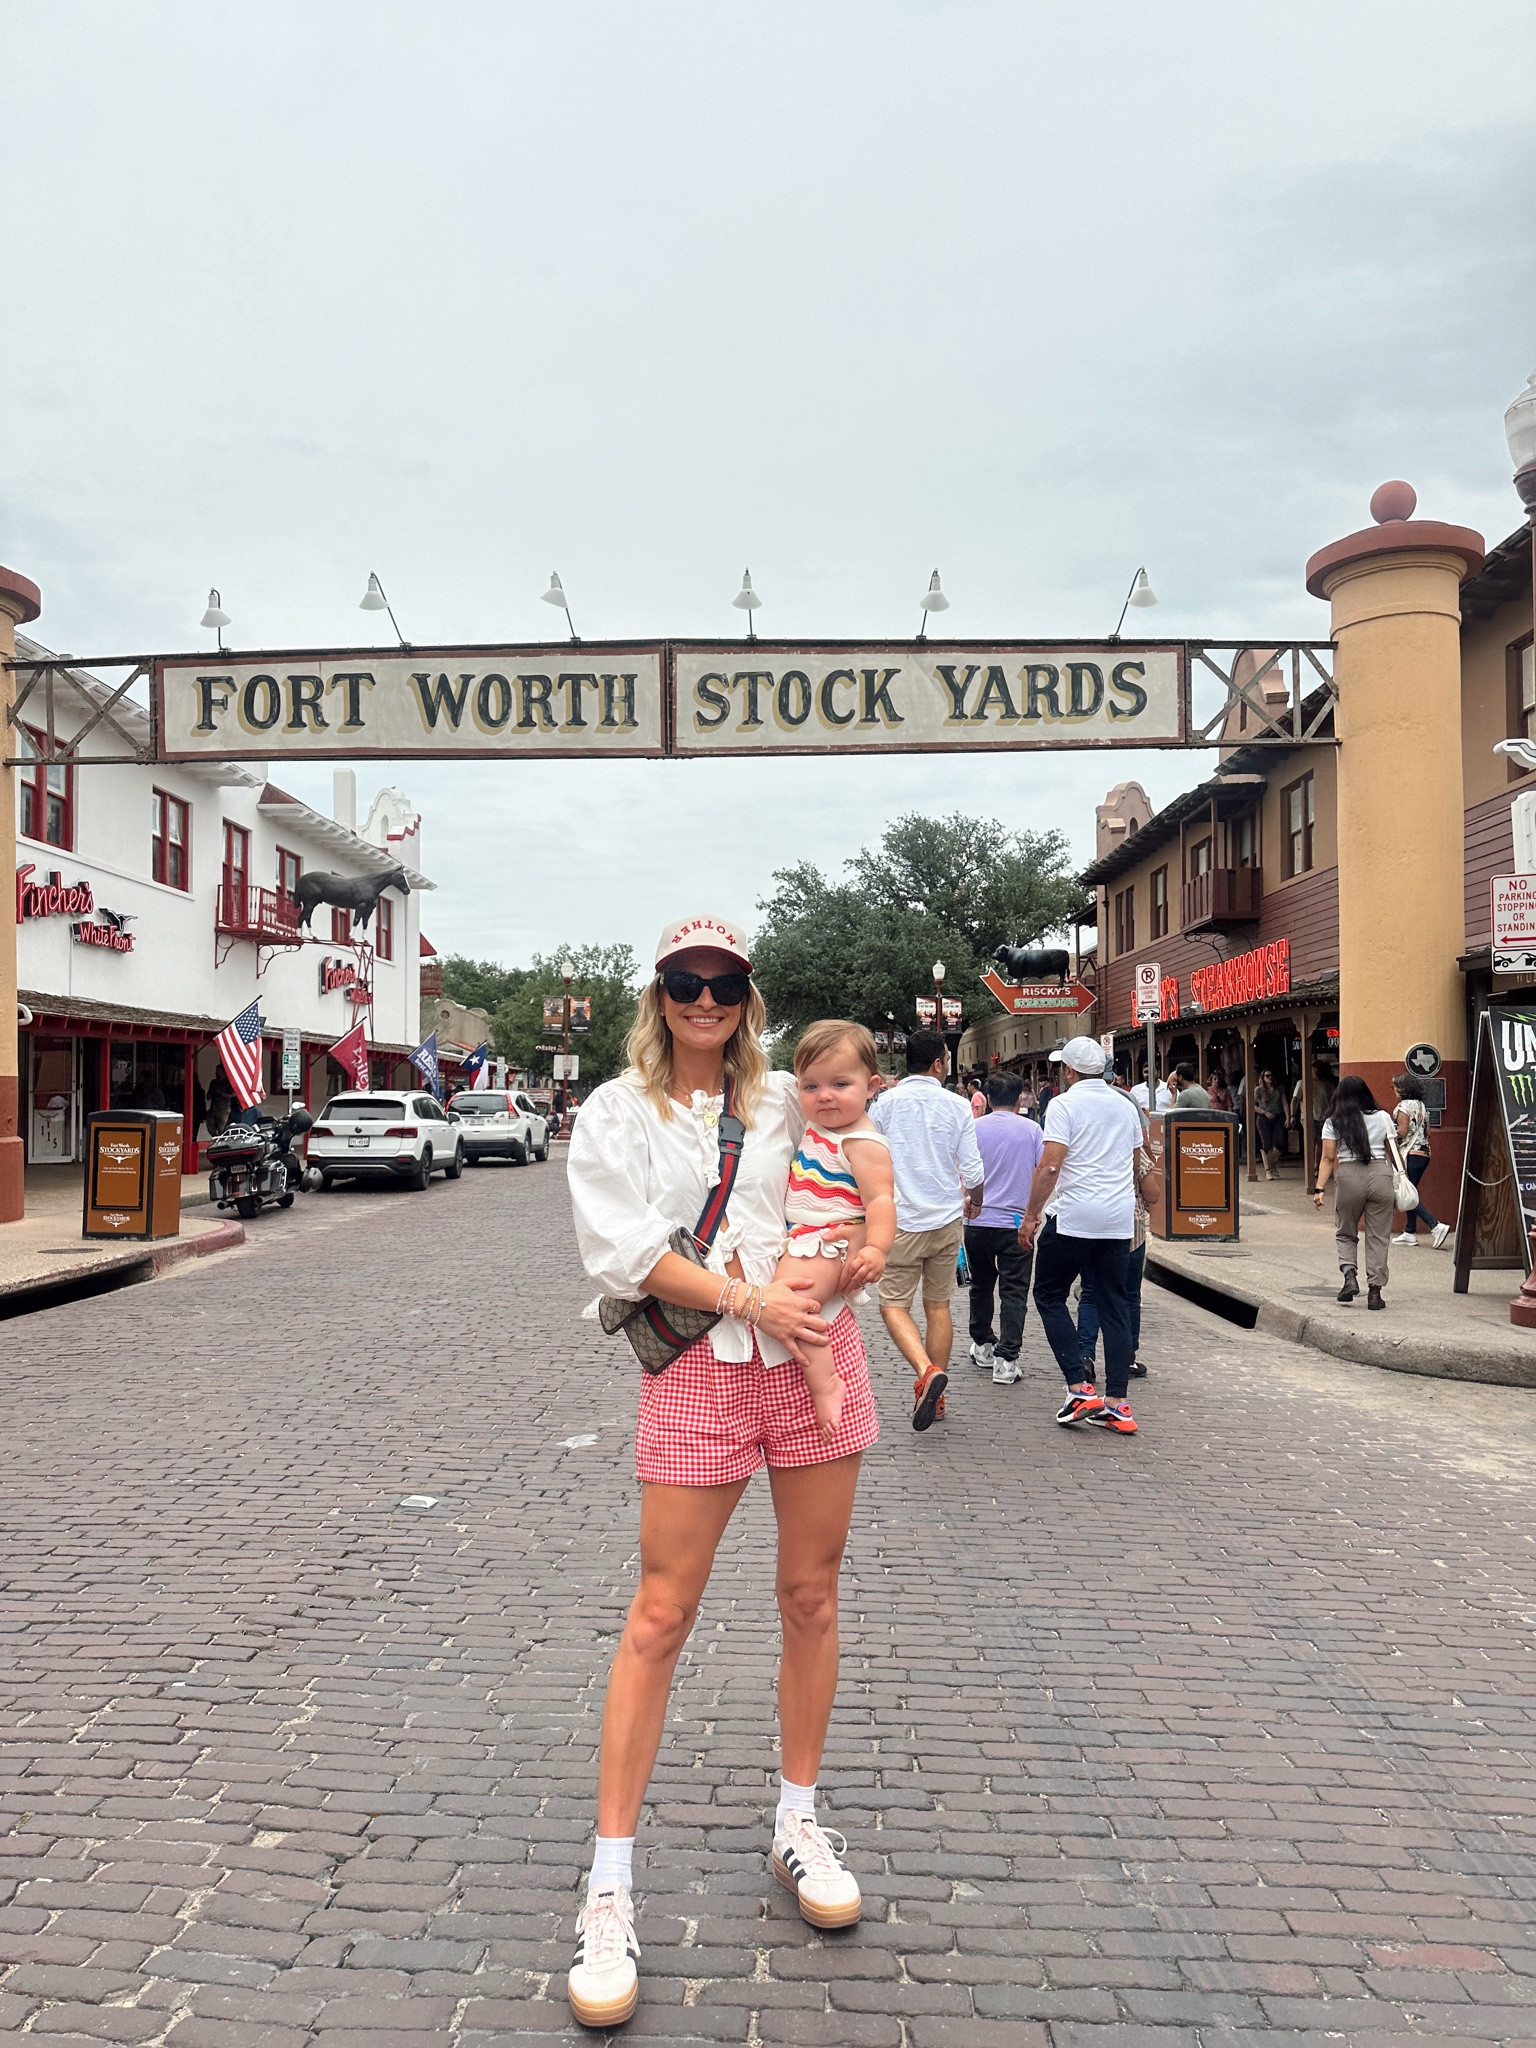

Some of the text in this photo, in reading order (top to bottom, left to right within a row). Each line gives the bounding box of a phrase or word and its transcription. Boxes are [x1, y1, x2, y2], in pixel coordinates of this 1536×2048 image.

[694, 660, 1150, 728] STOCK YARDS
[193, 671, 640, 733] FORT WORTH
[1509, 880, 1527, 890] NO
[16, 864, 94, 924] Fincher's
[1497, 901, 1536, 912] STOPPIN
[1513, 912, 1525, 921] OR
[671, 920, 736, 946] MOTHER
[1191, 937, 1289, 1012] STEAKHOUSE
[1022, 987, 1071, 996] RISCKY'S
[100, 1146, 140, 1154] STOCKYARDS
[1181, 1146, 1224, 1154] STOCKYARDS
